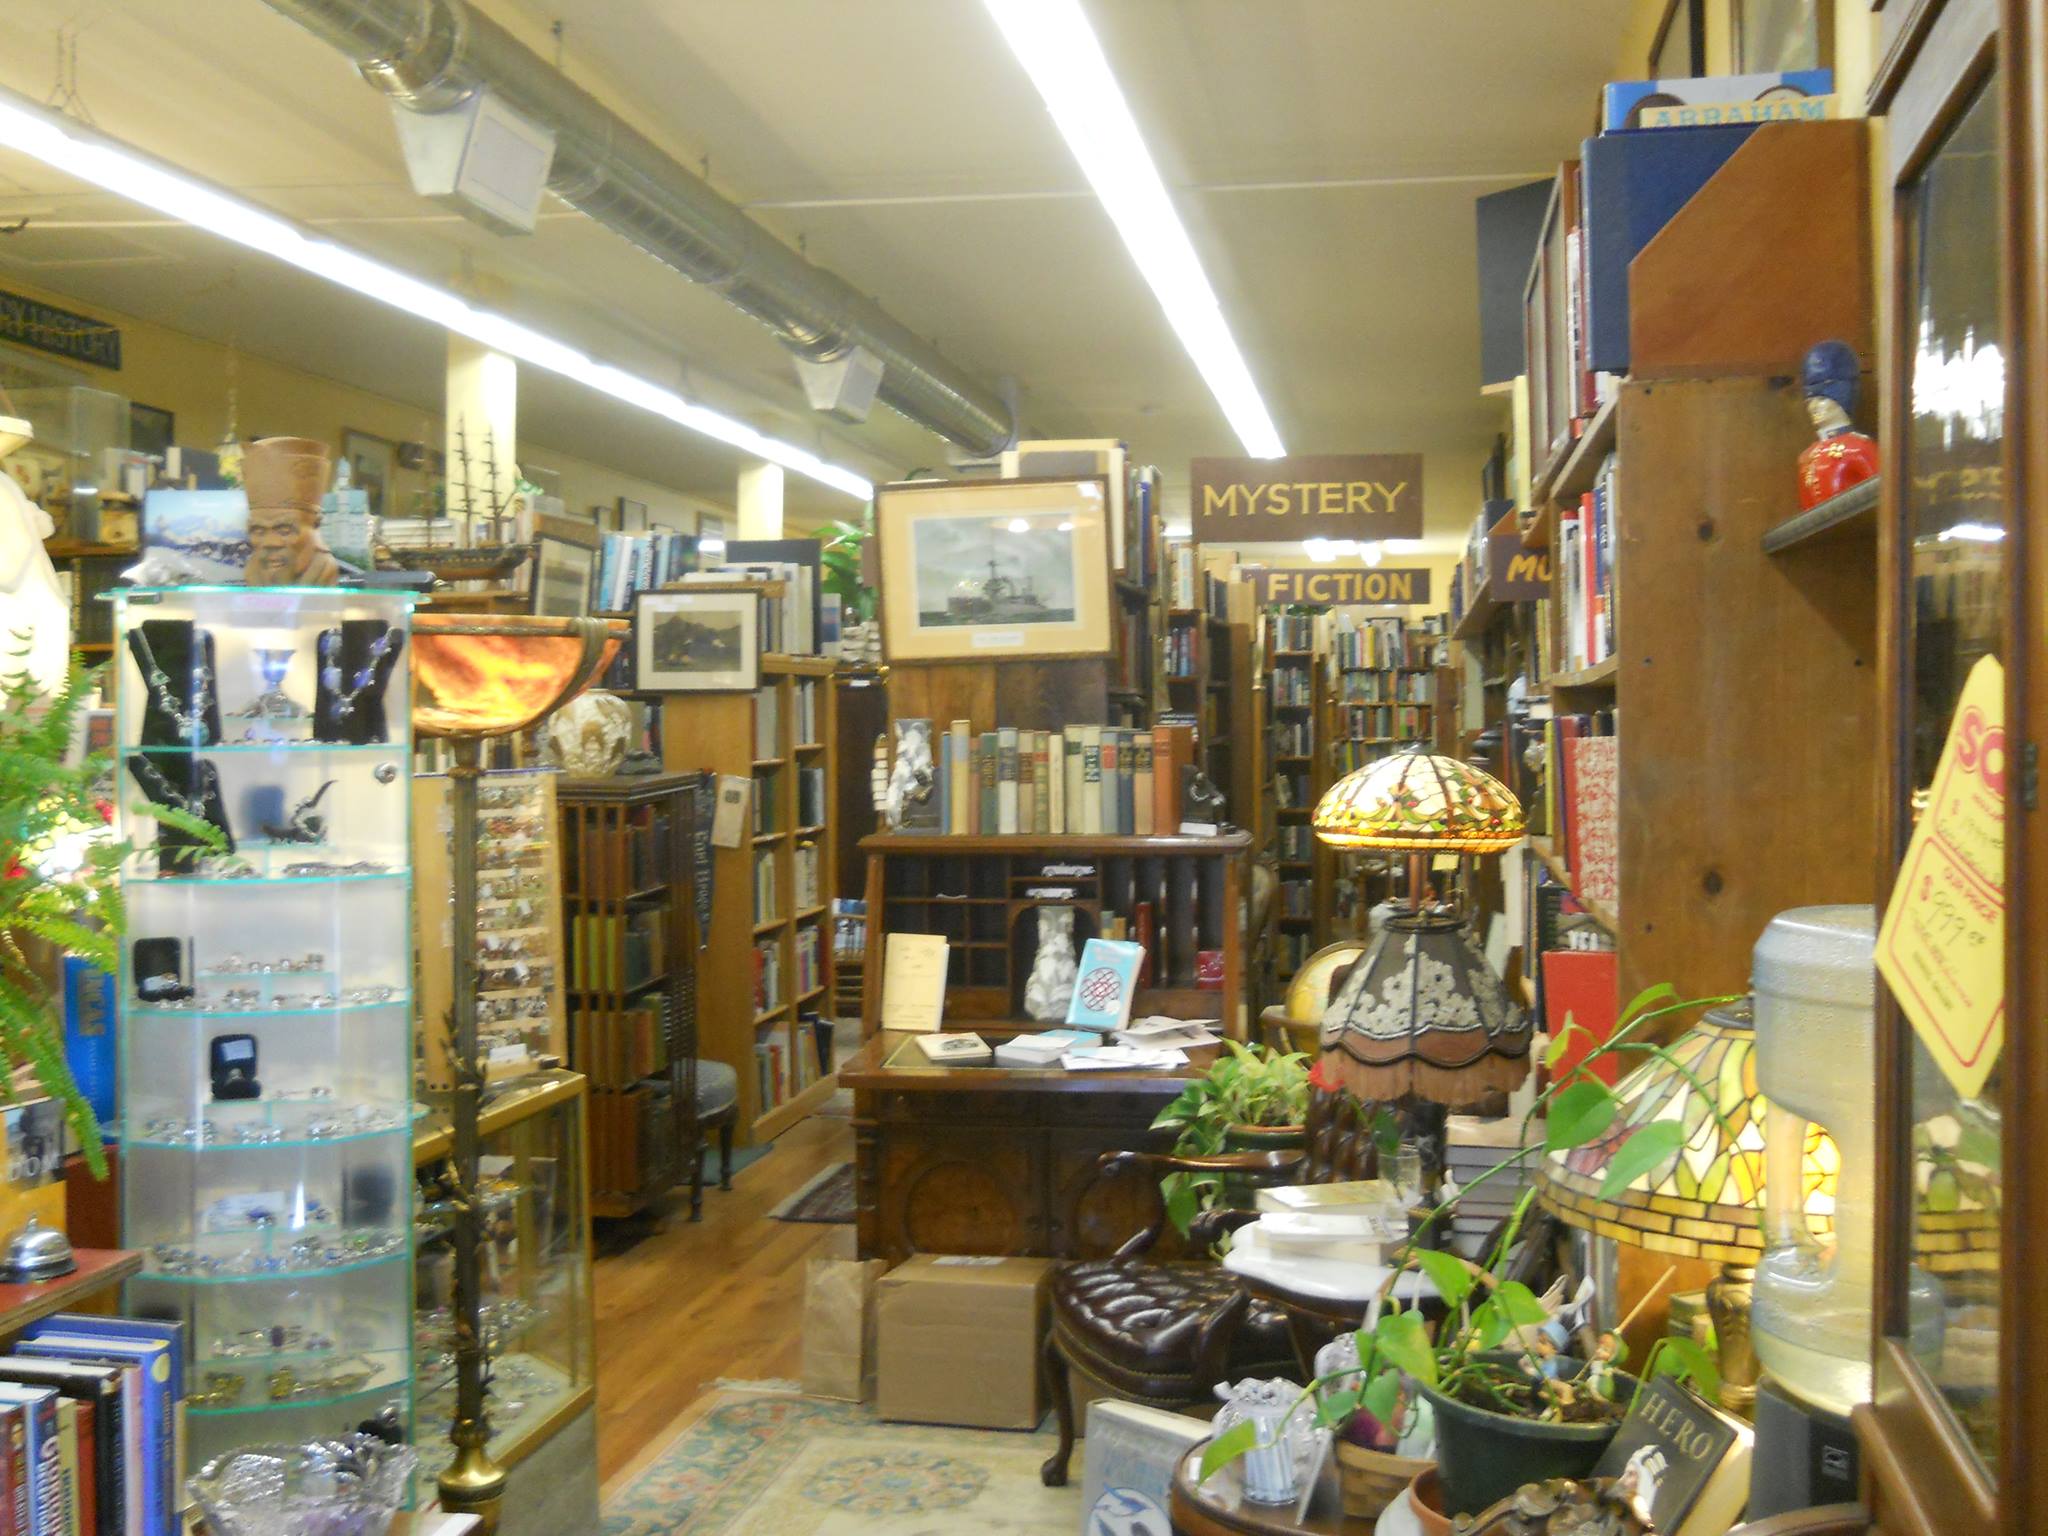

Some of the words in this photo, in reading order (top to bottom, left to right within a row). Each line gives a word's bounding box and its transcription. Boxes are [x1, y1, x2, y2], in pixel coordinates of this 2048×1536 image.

[1655, 101, 1826, 128] ABRAHAM
[1203, 481, 1408, 518] MYSTERY
[1268, 572, 1412, 602] FICTION
[1640, 1392, 1713, 1460] HERO
